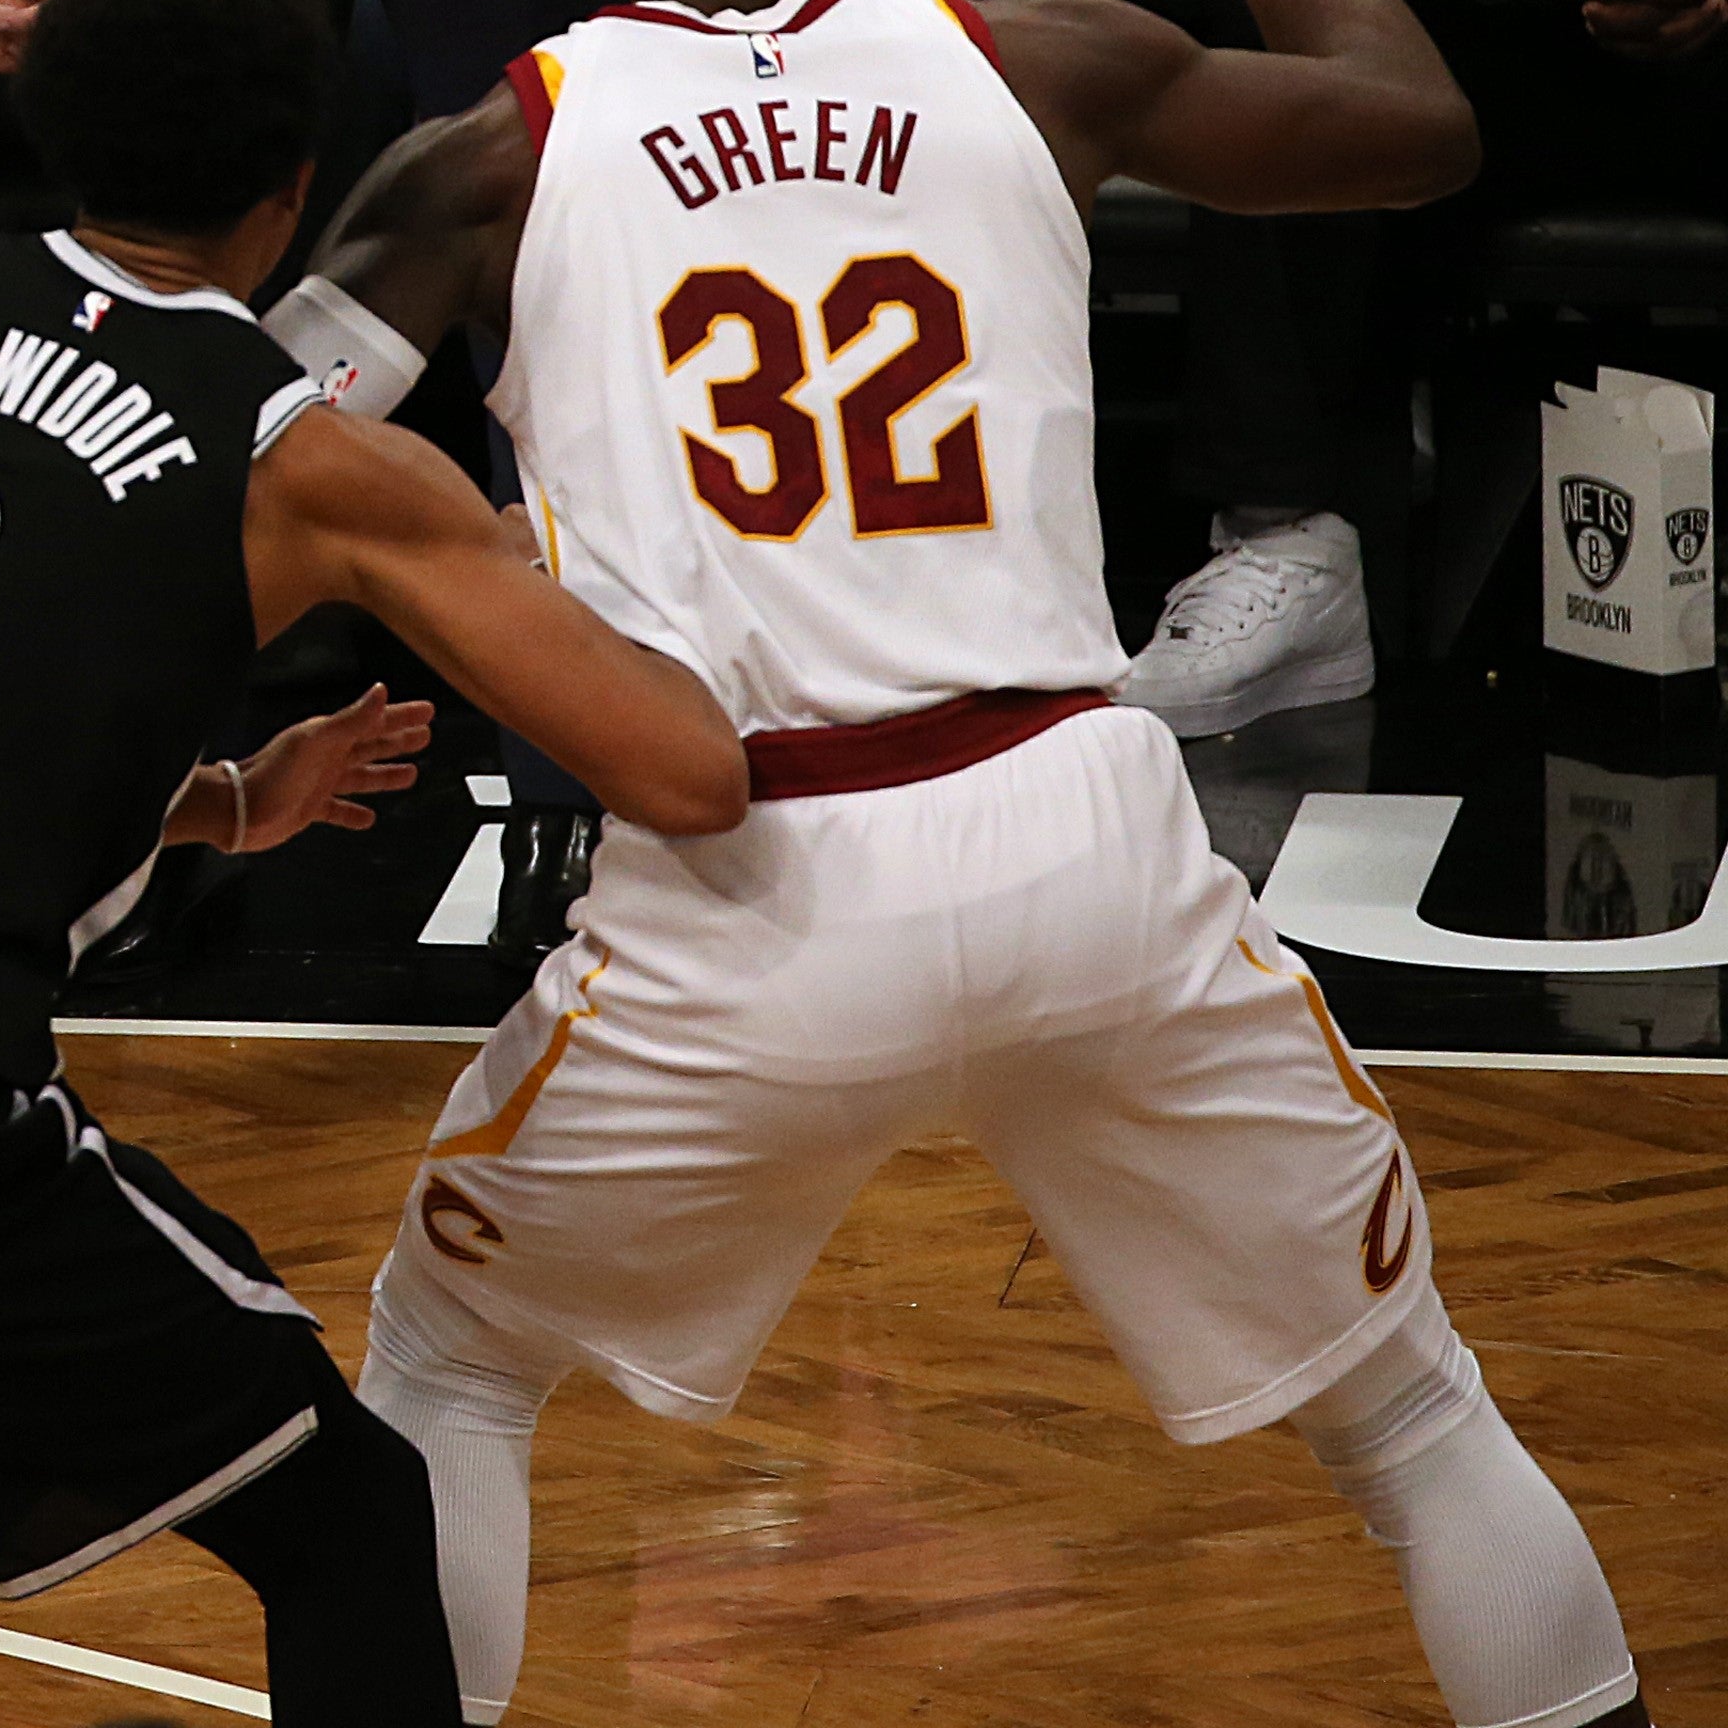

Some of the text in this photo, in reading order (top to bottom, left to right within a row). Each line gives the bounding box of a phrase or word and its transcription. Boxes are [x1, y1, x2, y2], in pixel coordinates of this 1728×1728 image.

[640, 98, 918, 211] GREEN
[656, 251, 993, 542] 32
[1562, 481, 1629, 537] NETS
[1566, 592, 1632, 634] BROOKLYN
